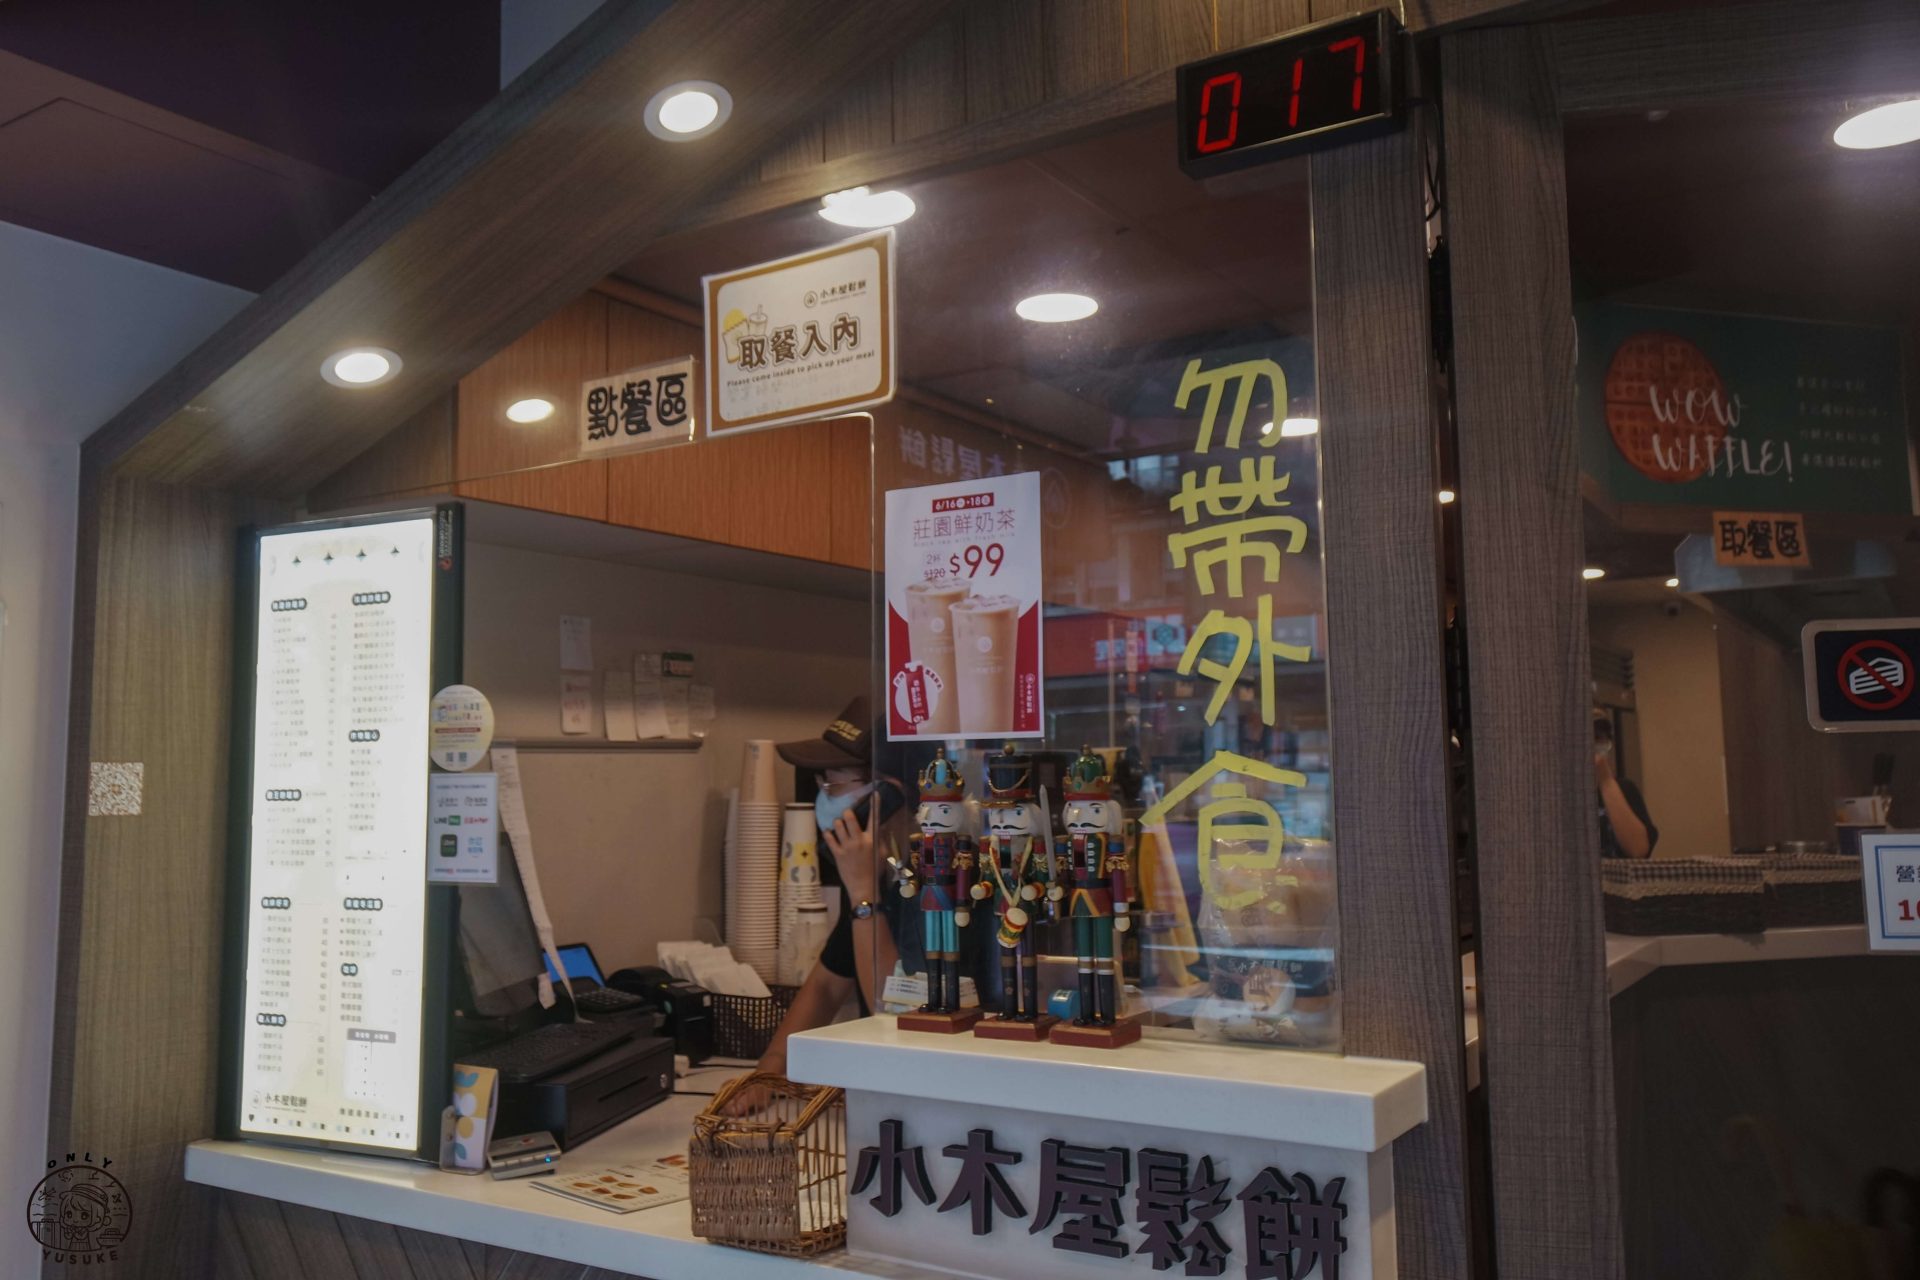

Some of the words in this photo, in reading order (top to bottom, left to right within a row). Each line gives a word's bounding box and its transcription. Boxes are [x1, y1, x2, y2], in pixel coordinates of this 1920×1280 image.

[1197, 36, 1365, 153] 017
[740, 316, 858, 369] 取餐入內
[727, 378, 750, 387] Please
[752, 373, 771, 383] come
[772, 368, 795, 378] inside
[807, 361, 823, 372] pick
[825, 359, 834, 368] up
[837, 355, 854, 366] your
[856, 349, 875, 359] meal
[588, 372, 687, 440] 點餐區
[1649, 385, 1747, 428] WOW
[1651, 433, 1794, 483] WAFFLE!
[913, 507, 1015, 540] 莊園鮮奶茶
[1718, 519, 1803, 560] 取餐區
[949, 542, 1005, 579] $99
[1138, 358, 1311, 913] 勿帶外食
[1896, 865, 1920, 883] 營
[850, 1118, 1349, 1280] 小木屋鬆餅
